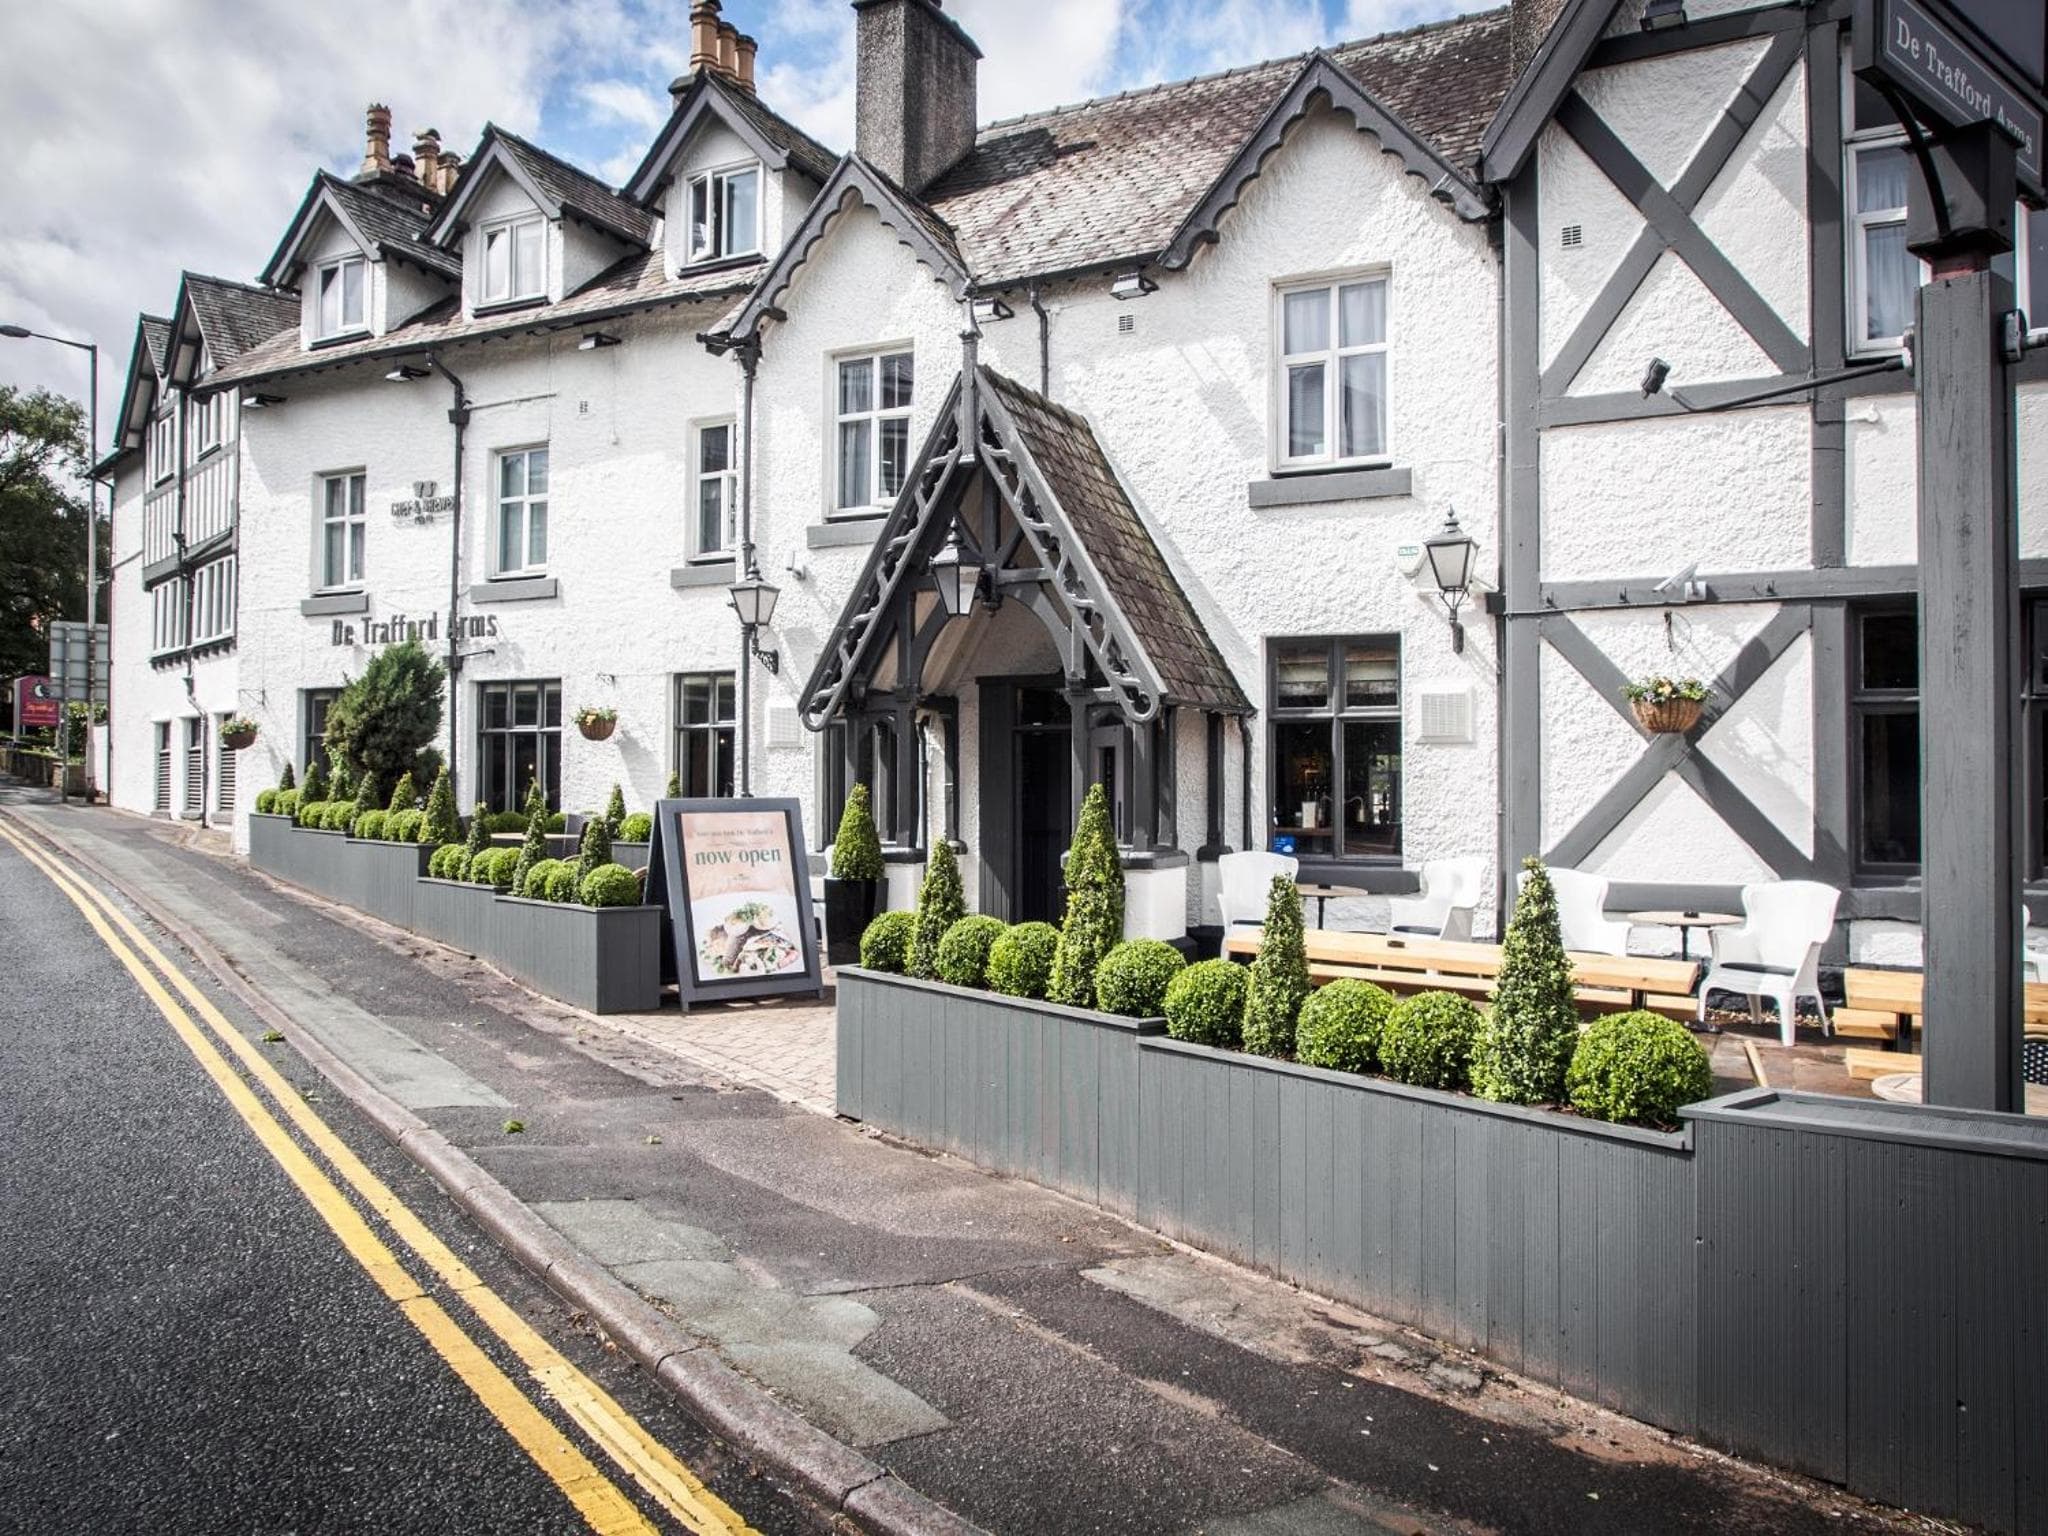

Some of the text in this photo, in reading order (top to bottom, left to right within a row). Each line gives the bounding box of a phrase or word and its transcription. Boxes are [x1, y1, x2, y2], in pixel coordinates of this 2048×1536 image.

[1896, 17, 1920, 60] De
[1926, 42, 1991, 119] Trafford
[332, 619, 354, 646] De
[361, 611, 438, 644] Trafford
[695, 847, 781, 868] now open
